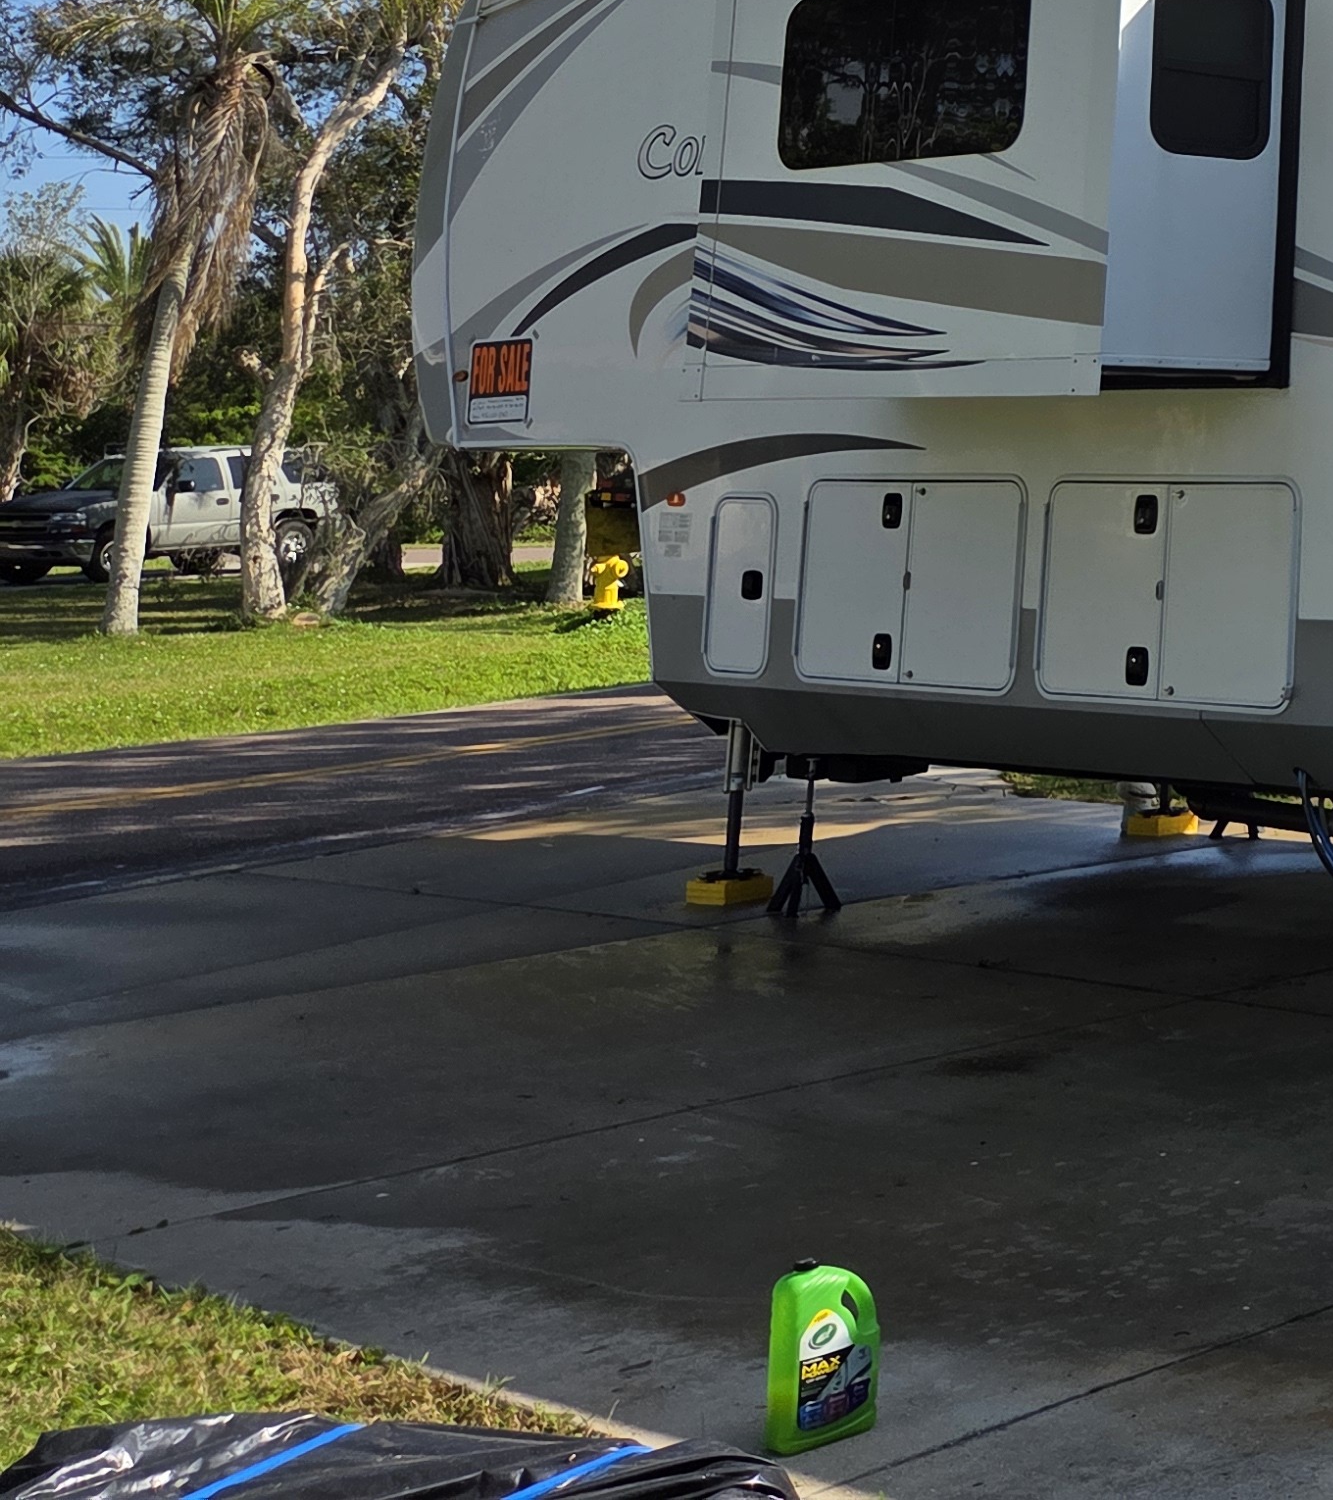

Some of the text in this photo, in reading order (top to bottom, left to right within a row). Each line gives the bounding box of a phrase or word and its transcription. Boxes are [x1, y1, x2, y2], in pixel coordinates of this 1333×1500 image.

[471, 343, 531, 395] FOR SALE
[802, 1355, 841, 1376] MAX
